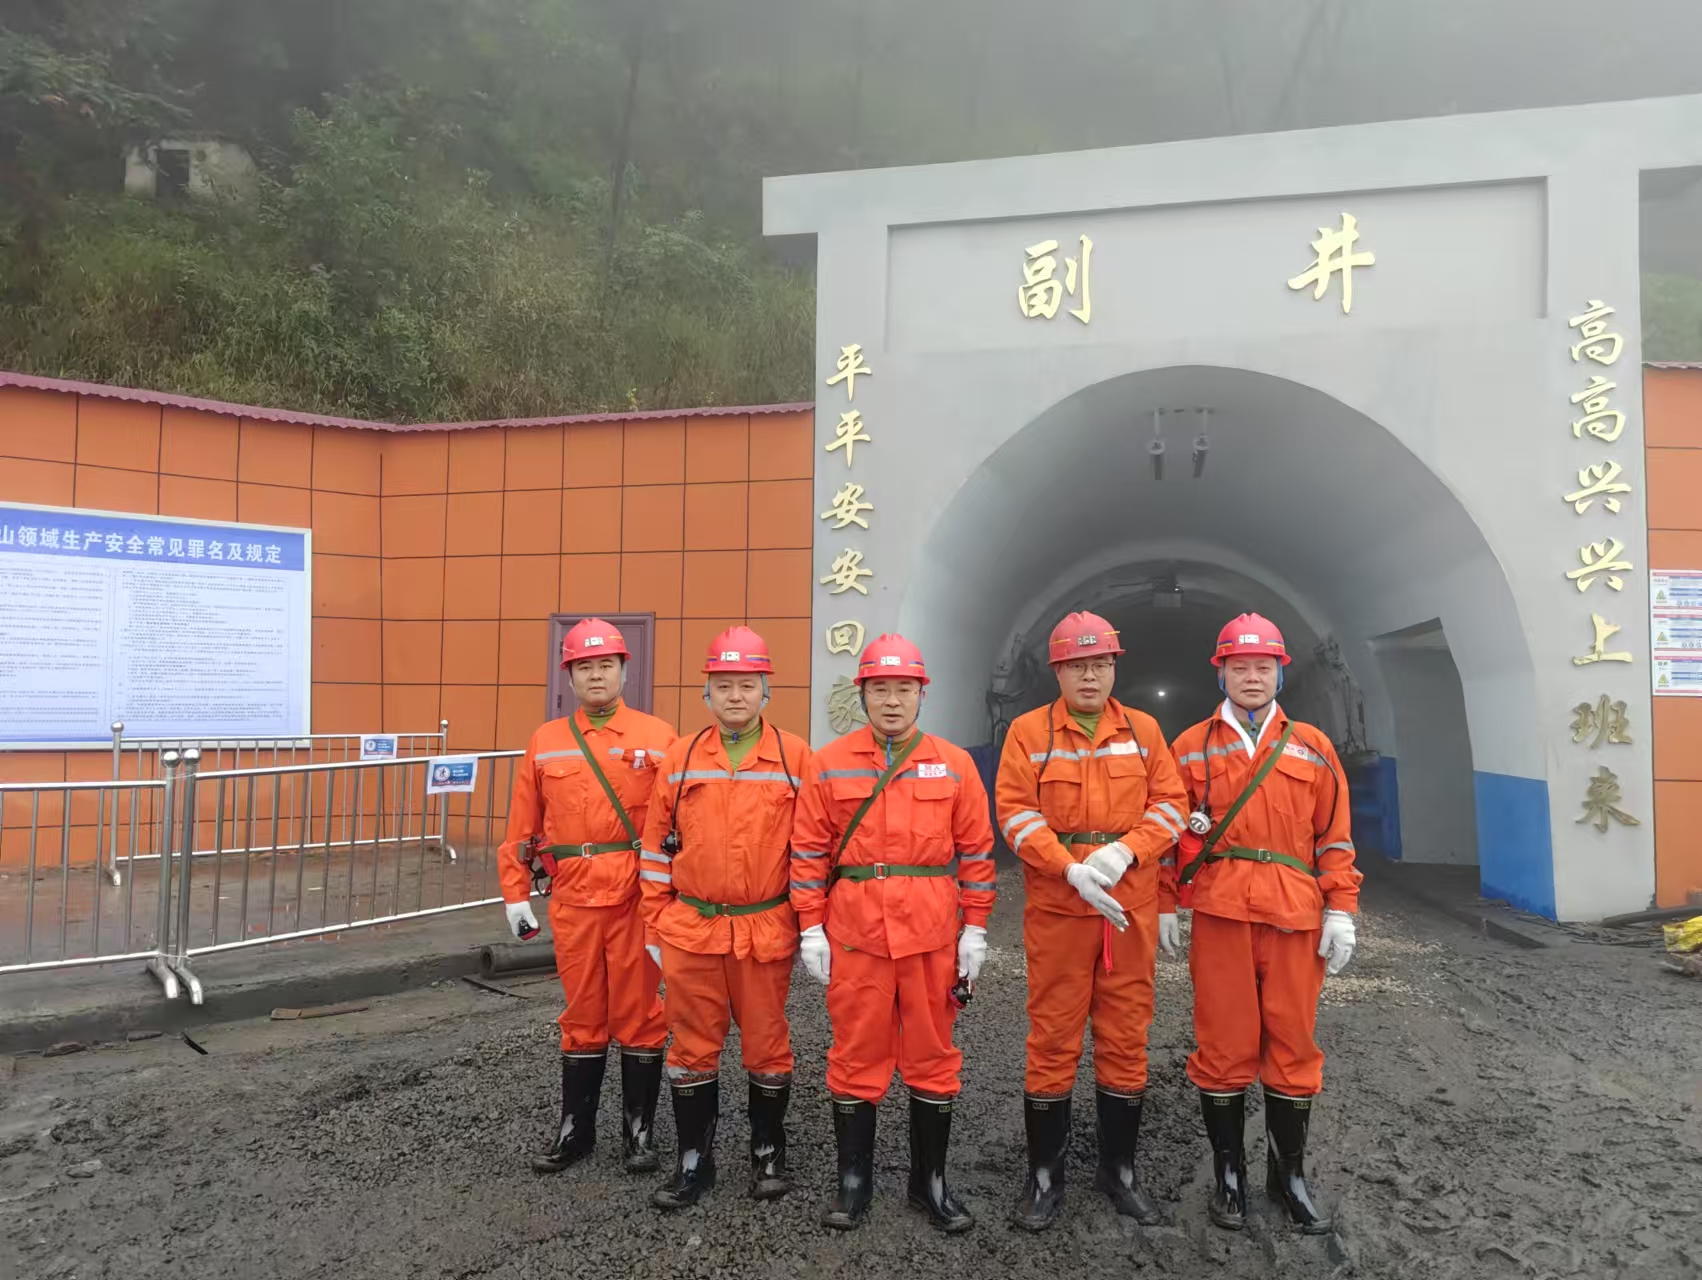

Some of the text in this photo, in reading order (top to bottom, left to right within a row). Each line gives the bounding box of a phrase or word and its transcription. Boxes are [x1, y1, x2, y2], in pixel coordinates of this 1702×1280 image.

[1018, 213, 1375, 324] 副井
[0, 524, 282, 564] 山领域生产安全常见罪名及规定
[820, 343, 874, 734] 平平安安回家
[1563, 299, 1641, 834] 高高兴兴上班来
